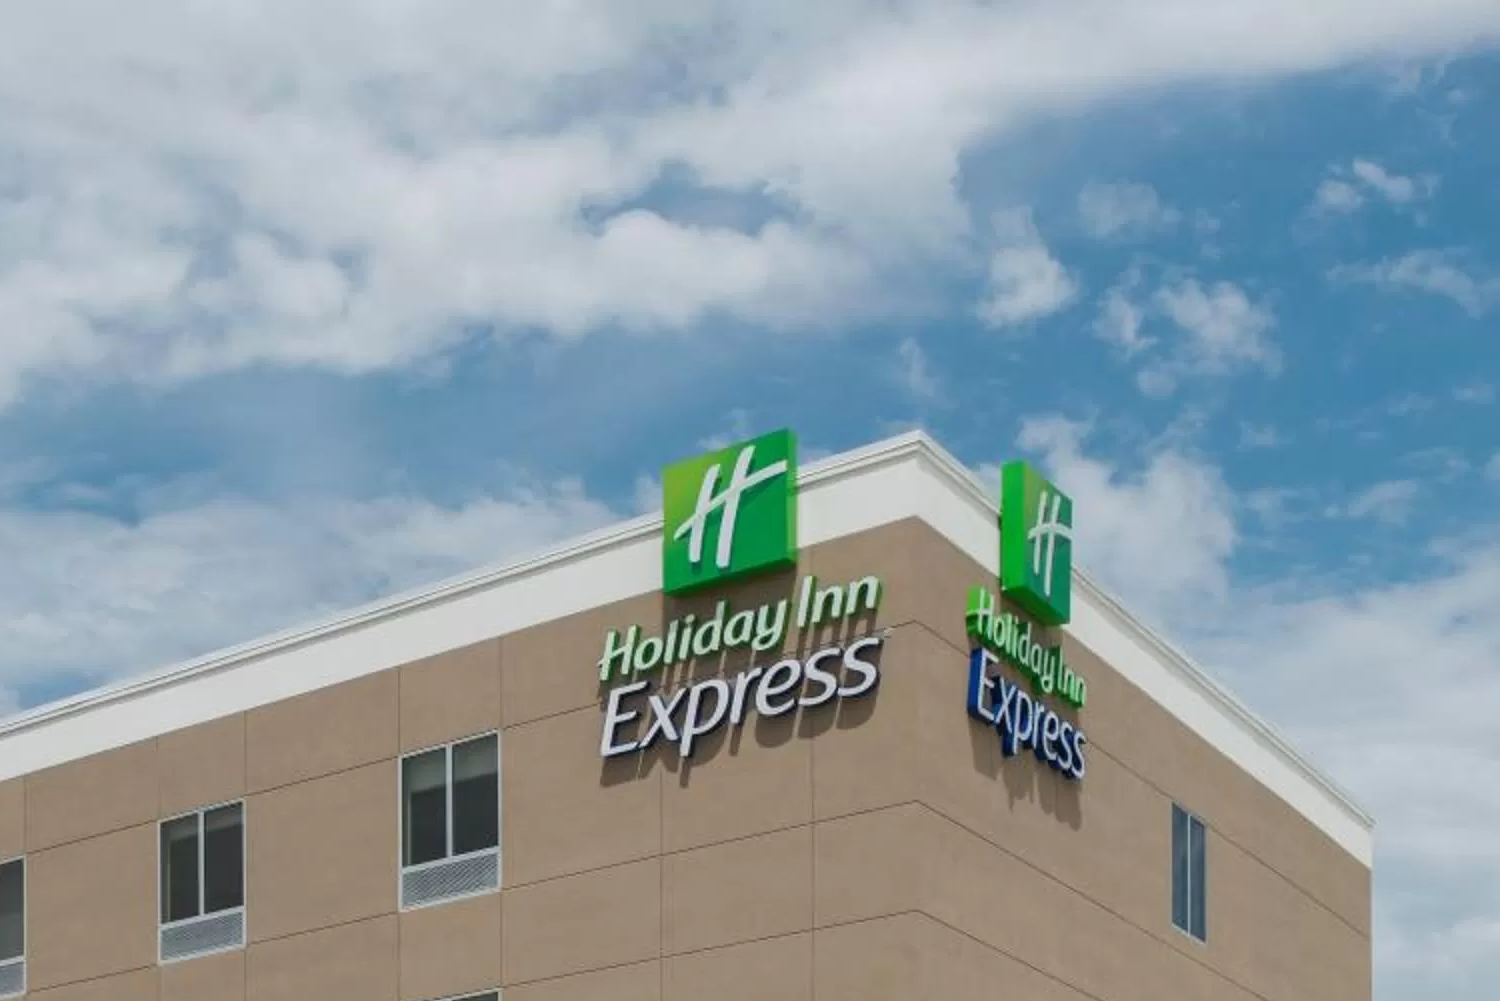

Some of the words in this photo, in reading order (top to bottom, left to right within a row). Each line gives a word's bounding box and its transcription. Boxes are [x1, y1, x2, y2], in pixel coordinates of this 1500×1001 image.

[597, 599, 789, 681] Holiday
[797, 575, 881, 628] Inn
[973, 587, 1056, 694] Holiday
[1057, 649, 1087, 706] Inn
[601, 637, 881, 758] Express
[975, 647, 1086, 779] Express
